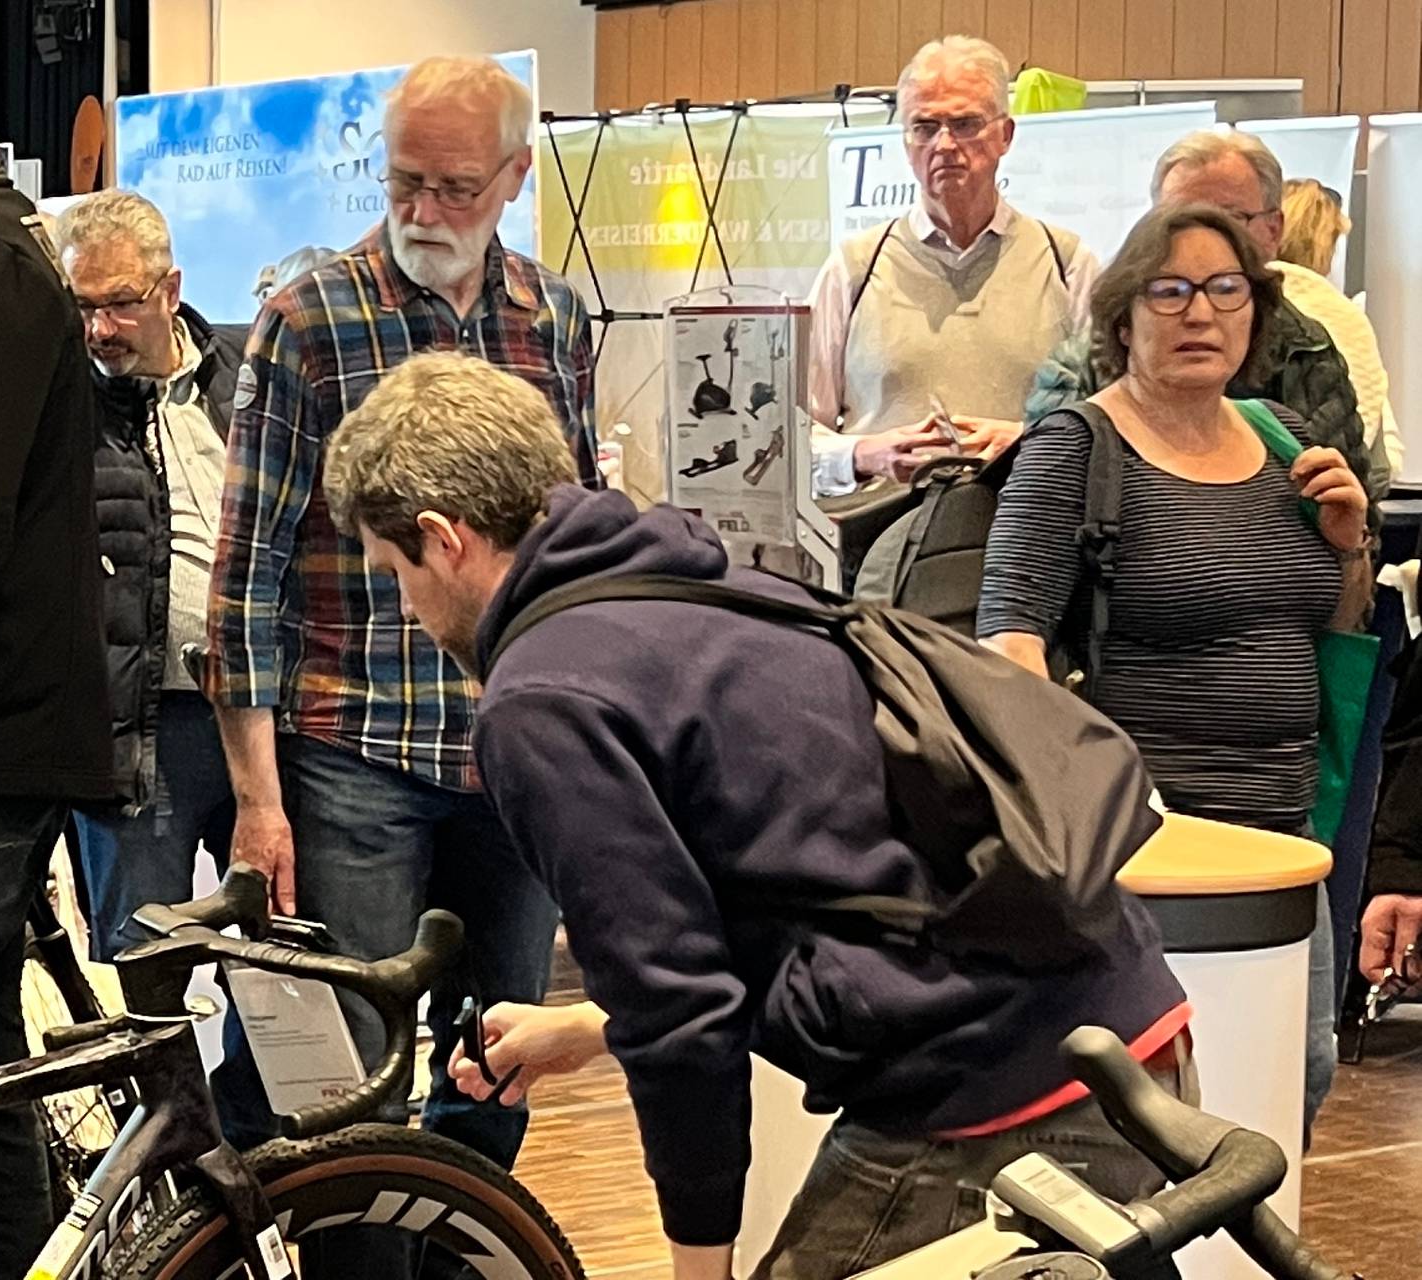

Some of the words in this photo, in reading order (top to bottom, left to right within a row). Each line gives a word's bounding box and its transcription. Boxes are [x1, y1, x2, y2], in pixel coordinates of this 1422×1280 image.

[202, 132, 260, 155] EIGENEN
[178, 163, 204, 184] RAD
[206, 161, 233, 182] AUF
